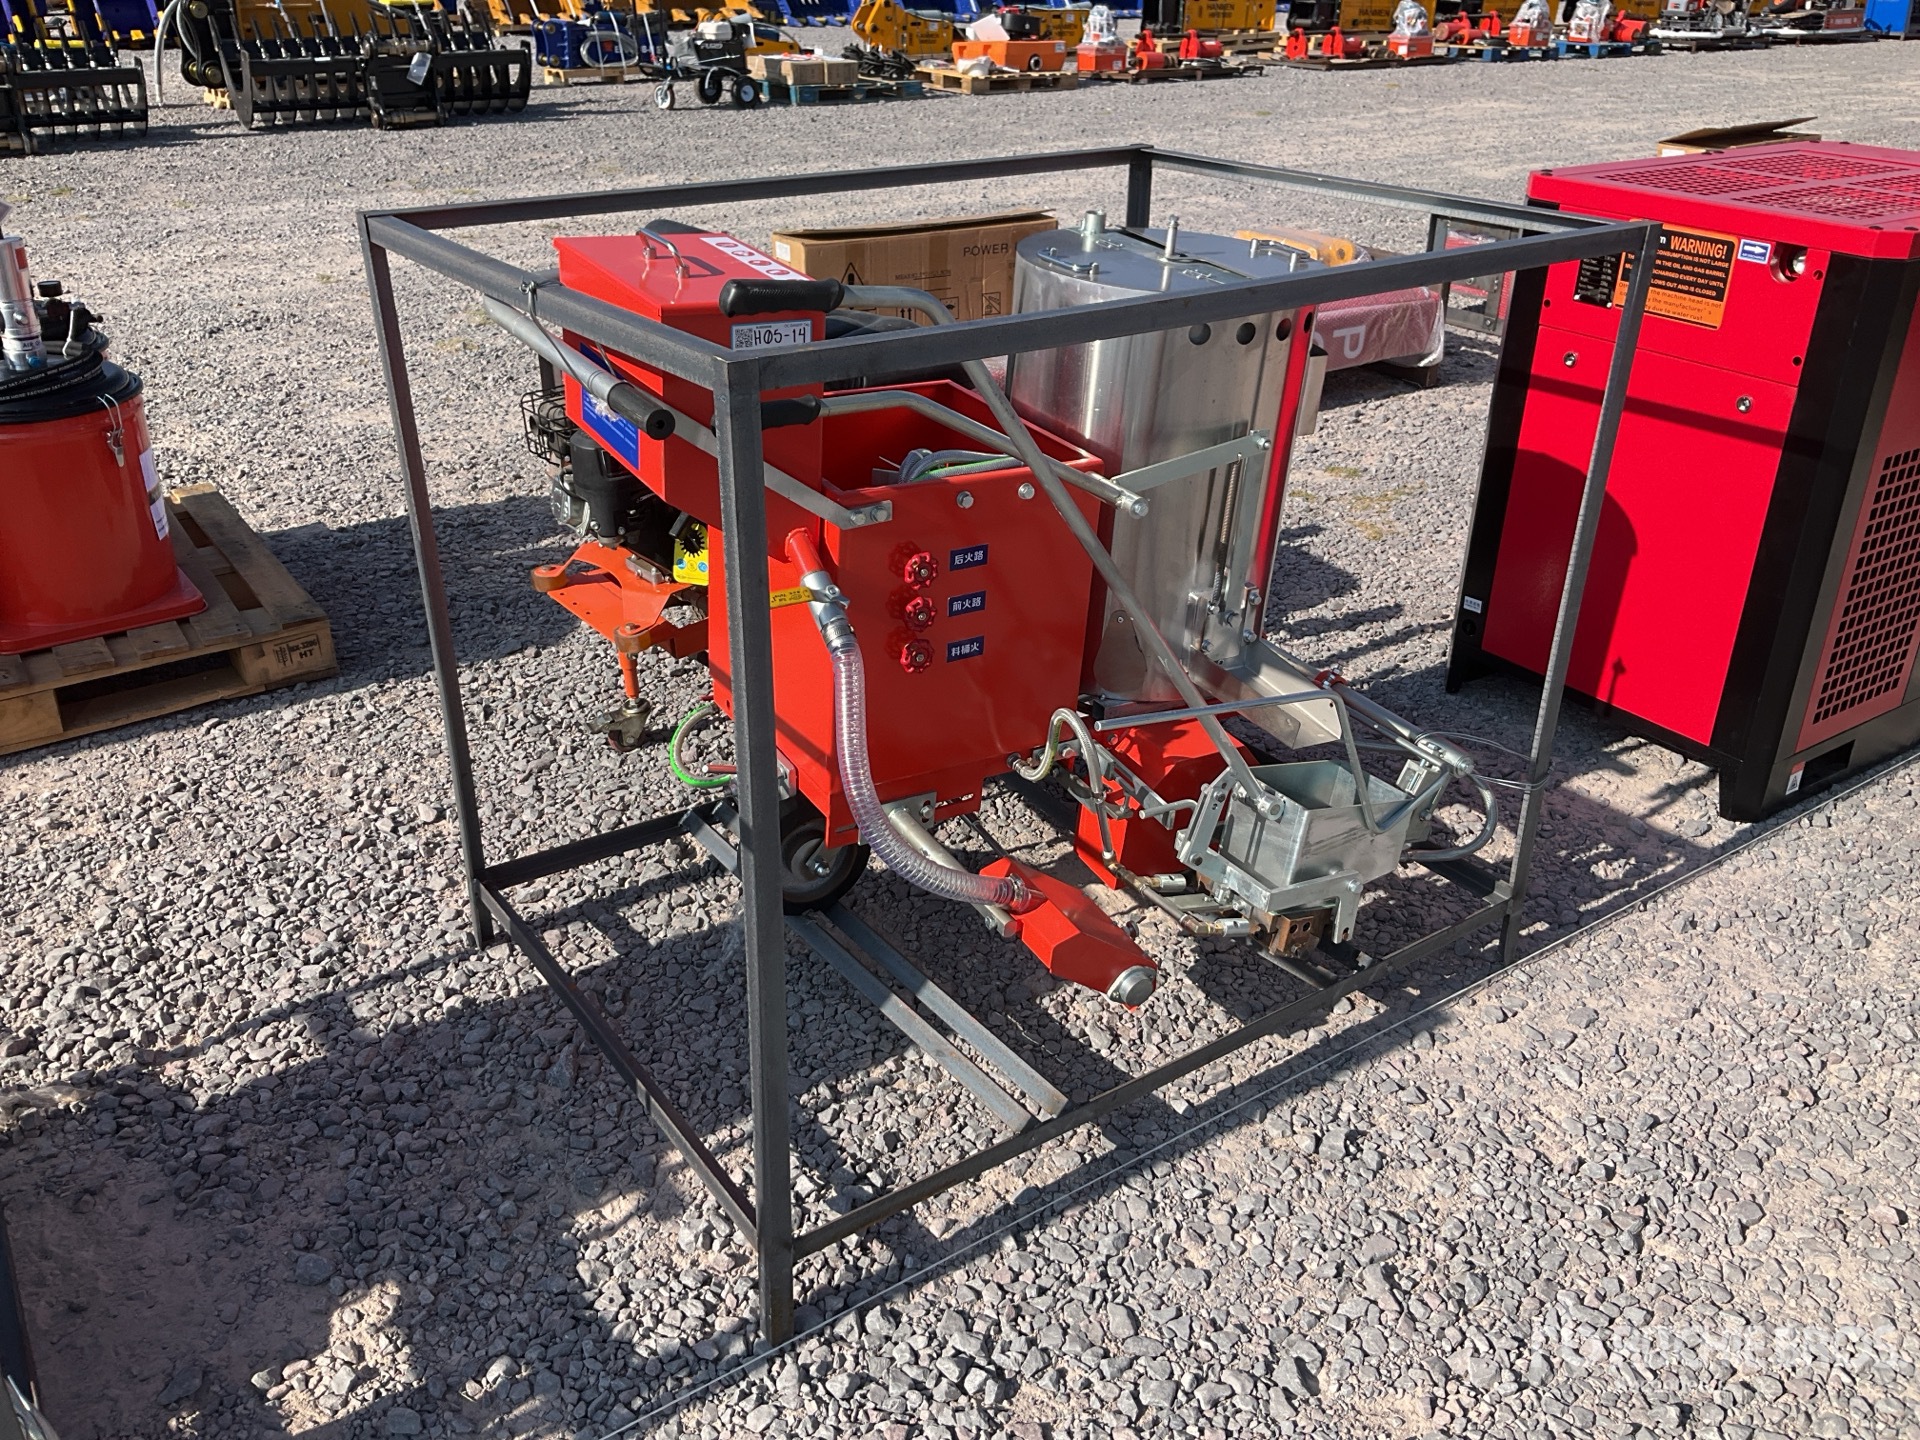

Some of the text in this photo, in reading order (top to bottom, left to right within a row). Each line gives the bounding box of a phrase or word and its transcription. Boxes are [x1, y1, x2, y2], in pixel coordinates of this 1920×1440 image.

[963, 243, 1009, 257] POWER
[1670, 236, 1728, 260] WARNING!
[1672, 262, 1681, 270] OIL
[1705, 269, 1727, 278] BARREL
[1711, 259, 1730, 268] LARGE
[1680, 273, 1697, 282] EVERY
[1709, 281, 1725, 289] UNTIL
[1661, 291, 1688, 301] machine
[1688, 296, 1704, 304] head
[1711, 302, 1722, 310] not
[1695, 288, 1717, 297] CLOSED
[753, 326, 806, 346] H05-14
[952, 596, 982, 612] 前火路
[299, 648, 314, 659] HT
[950, 641, 980, 657] 料桶火
